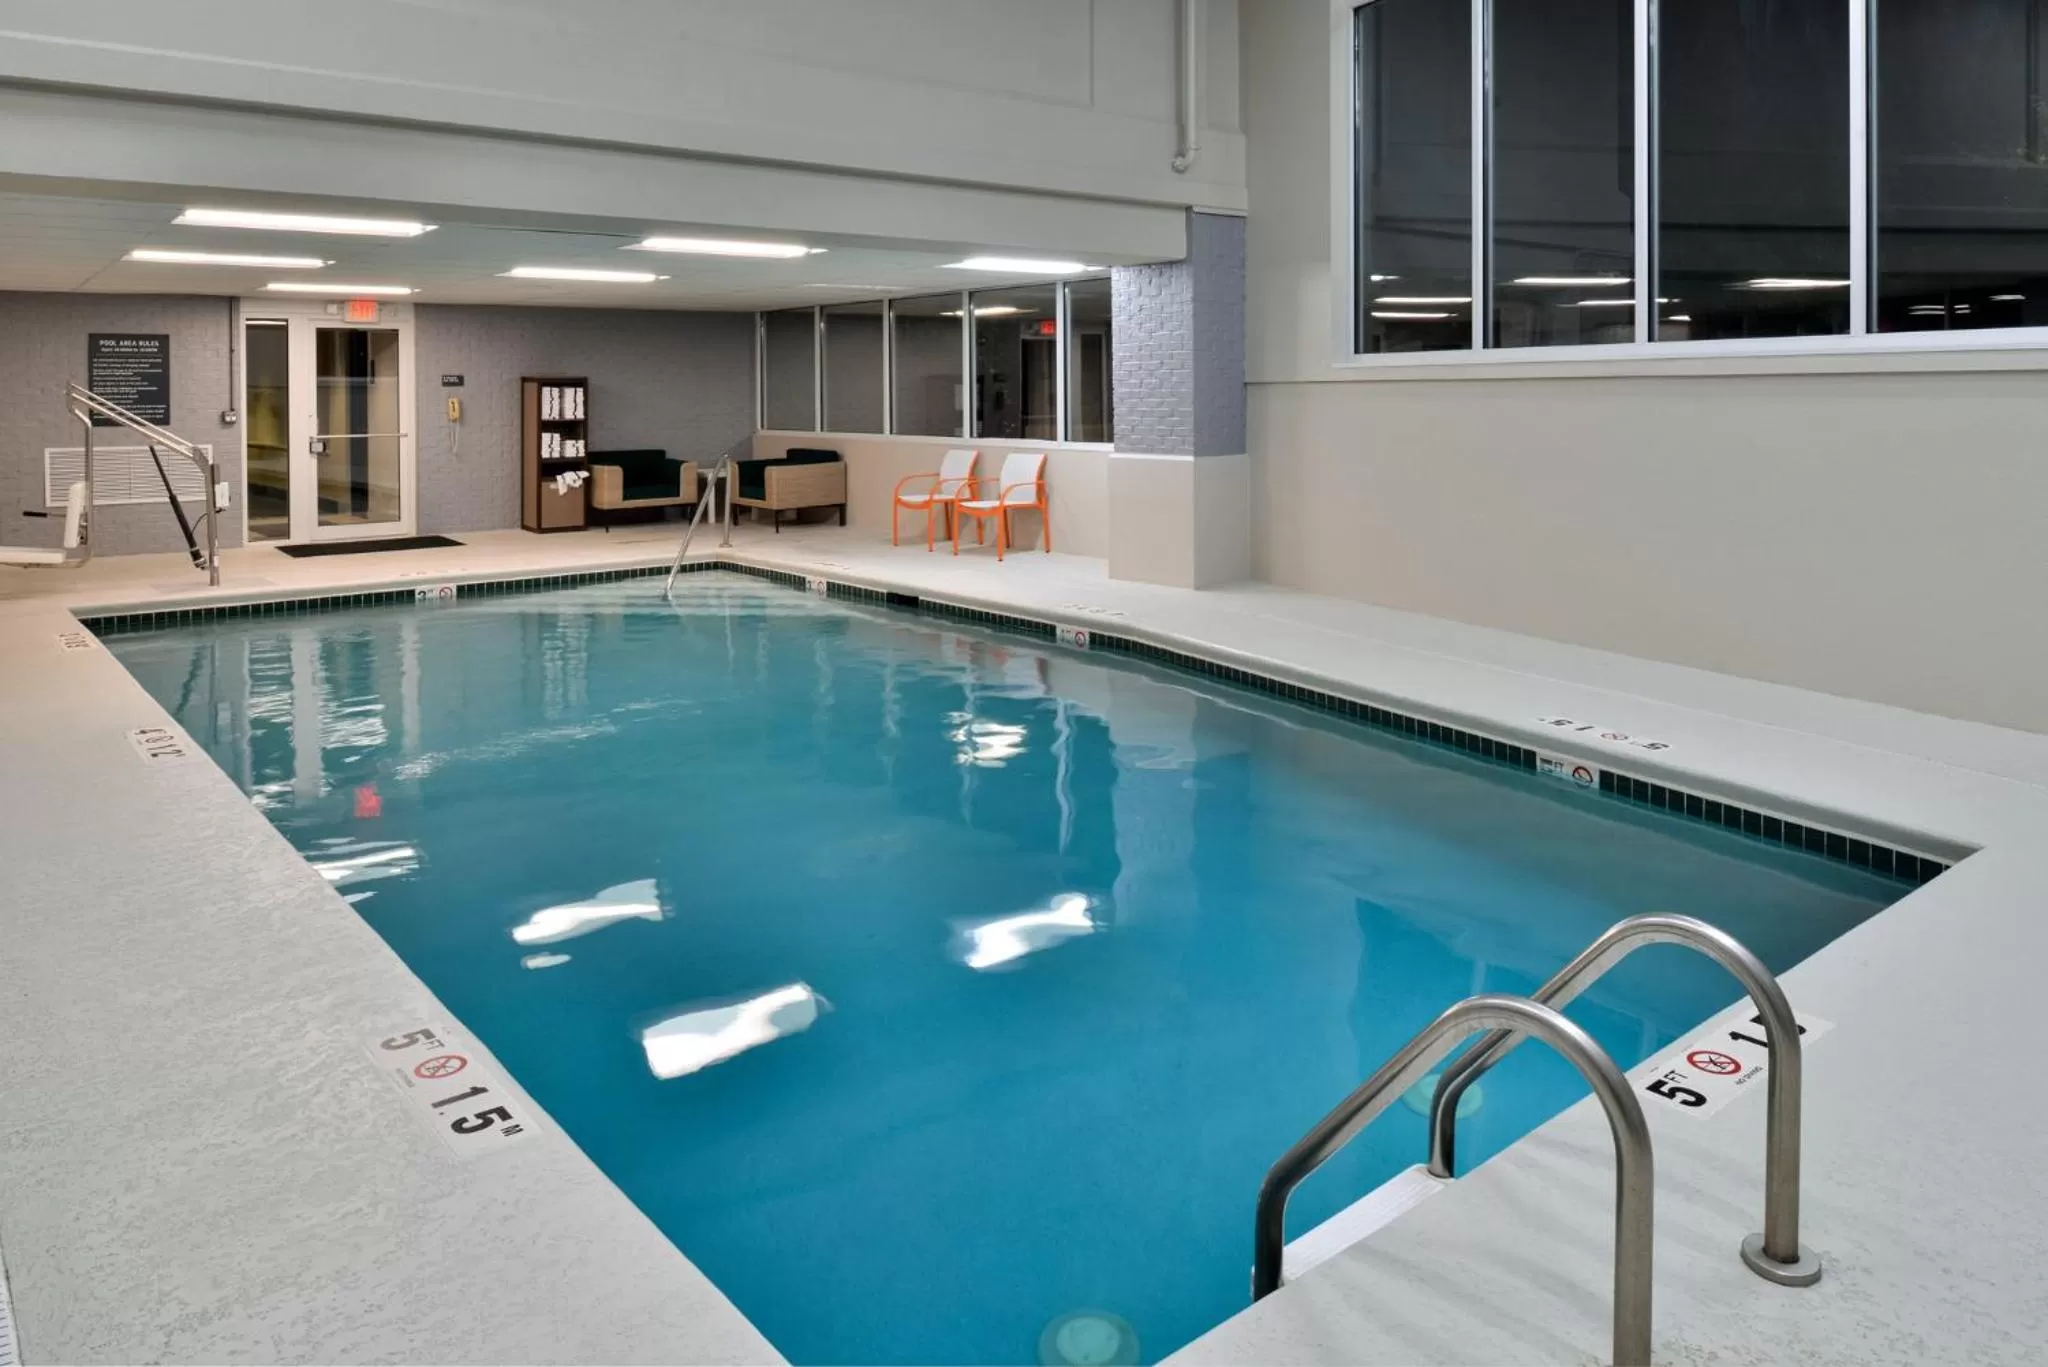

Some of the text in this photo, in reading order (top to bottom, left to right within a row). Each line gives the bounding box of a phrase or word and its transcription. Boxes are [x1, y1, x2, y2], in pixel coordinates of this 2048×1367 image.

[119, 339, 137, 347] AREA
[380, 1028, 436, 1050] 5
[431, 1085, 514, 1135] 1.5
[1646, 1069, 1708, 1108] 5 FT
